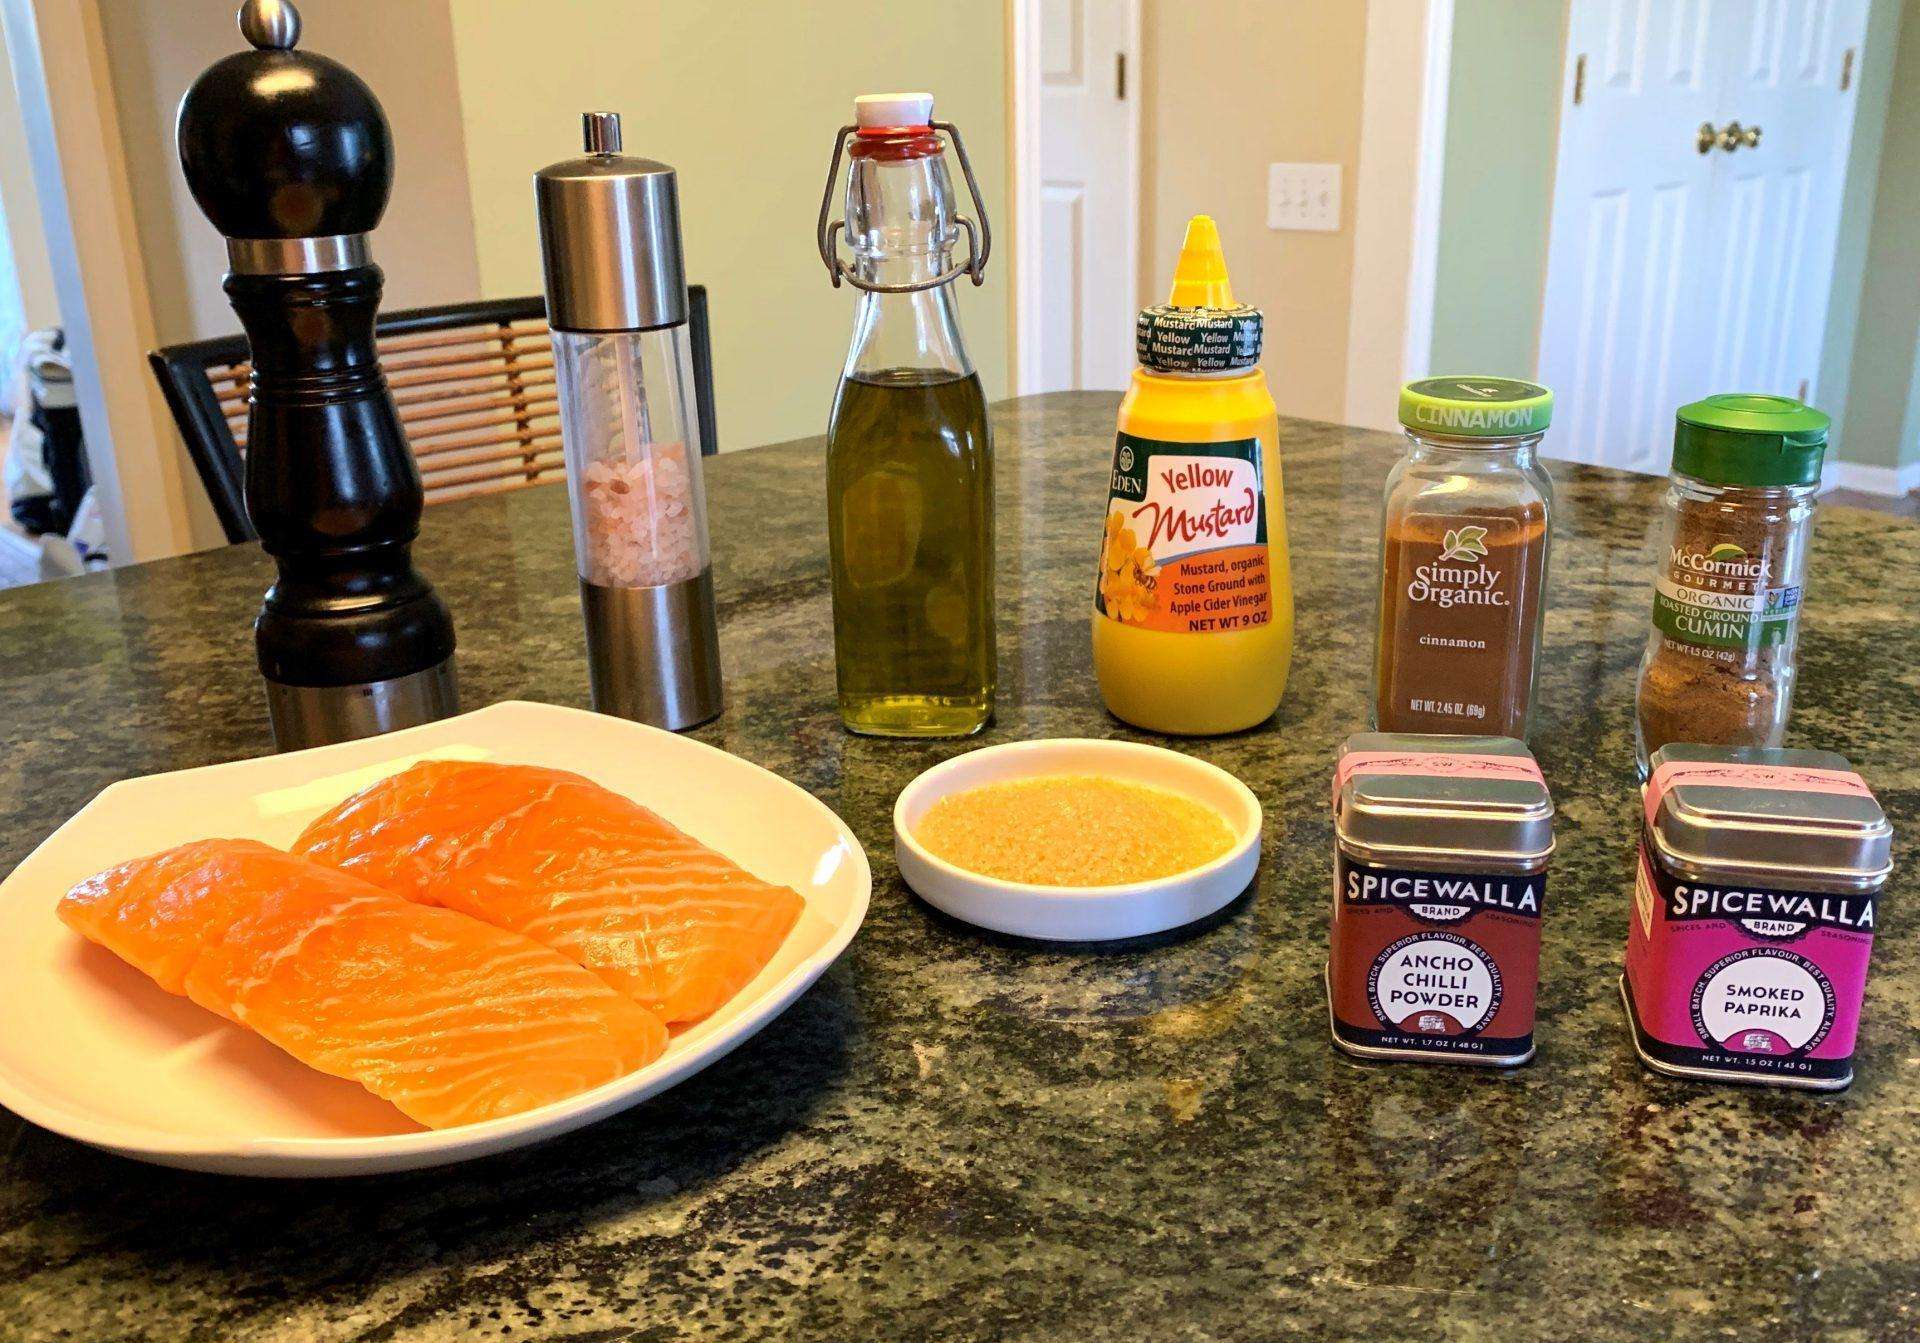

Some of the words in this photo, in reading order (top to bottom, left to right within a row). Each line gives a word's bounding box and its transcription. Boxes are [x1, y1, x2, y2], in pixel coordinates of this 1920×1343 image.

[1196, 318, 1233, 329] Mustard
[1156, 331, 1190, 344] Yellow
[1200, 331, 1229, 343] Yellow
[1193, 343, 1231, 355] Mustard
[1156, 357, 1190, 368] Yellow
[1197, 357, 1226, 368] Yellow
[1416, 402, 1533, 429] CINNAMON
[1111, 469, 1142, 494] EDEN
[1160, 462, 1234, 493] Yellow
[1132, 486, 1255, 550] Mustard
[1180, 560, 1228, 577] Mustard,
[1230, 554, 1265, 573] organic
[1669, 544, 1774, 579] McCormick
[1173, 580, 1205, 595] Stone
[1208, 576, 1245, 592] Ground
[1247, 574, 1266, 586] with
[1415, 561, 1502, 590] Simply
[1673, 570, 1762, 591] GOURMET
[1170, 599, 1201, 616] Apple
[1203, 597, 1231, 612] Cider
[1232, 591, 1268, 610] Vinegar
[1676, 588, 1756, 610] ORGANIC
[1189, 618, 1216, 631] NET
[1219, 616, 1239, 629] WT
[1242, 614, 1250, 626] 9
[1252, 610, 1268, 624] OZ
[1703, 610, 1759, 623] GROUND
[1675, 615, 1745, 640] CUMIN
[1419, 633, 1486, 649] cinnamon
[1701, 648, 1715, 658] OZ
[1410, 699, 1424, 711] NET
[1436, 701, 1453, 714] 2.45
[1466, 703, 1486, 719] (69g)
[1347, 870, 1537, 912] SPICEWALLA
[1421, 905, 1461, 917] BRAND
[1672, 885, 1874, 928] SPICEWALLA
[1753, 920, 1795, 932] BRAND
[1399, 954, 1474, 972] ANCHO
[1369, 993, 1387, 1022] SMALL
[1378, 935, 1419, 963] SUPERIOR
[1469, 942, 1491, 962] BEST
[1403, 972, 1468, 990] CHILLI
[1390, 989, 1479, 1009] POWDER
[1692, 1013, 1710, 1040] SMALL
[1704, 950, 1749, 979] SUPERIOR
[1802, 961, 1825, 981] BEST
[1726, 984, 1805, 1002] SMOKED
[1724, 1001, 1802, 1019] PAPRIKA
[1381, 1036, 1398, 1044] NET
[1758, 1059, 1773, 1067] OZ
